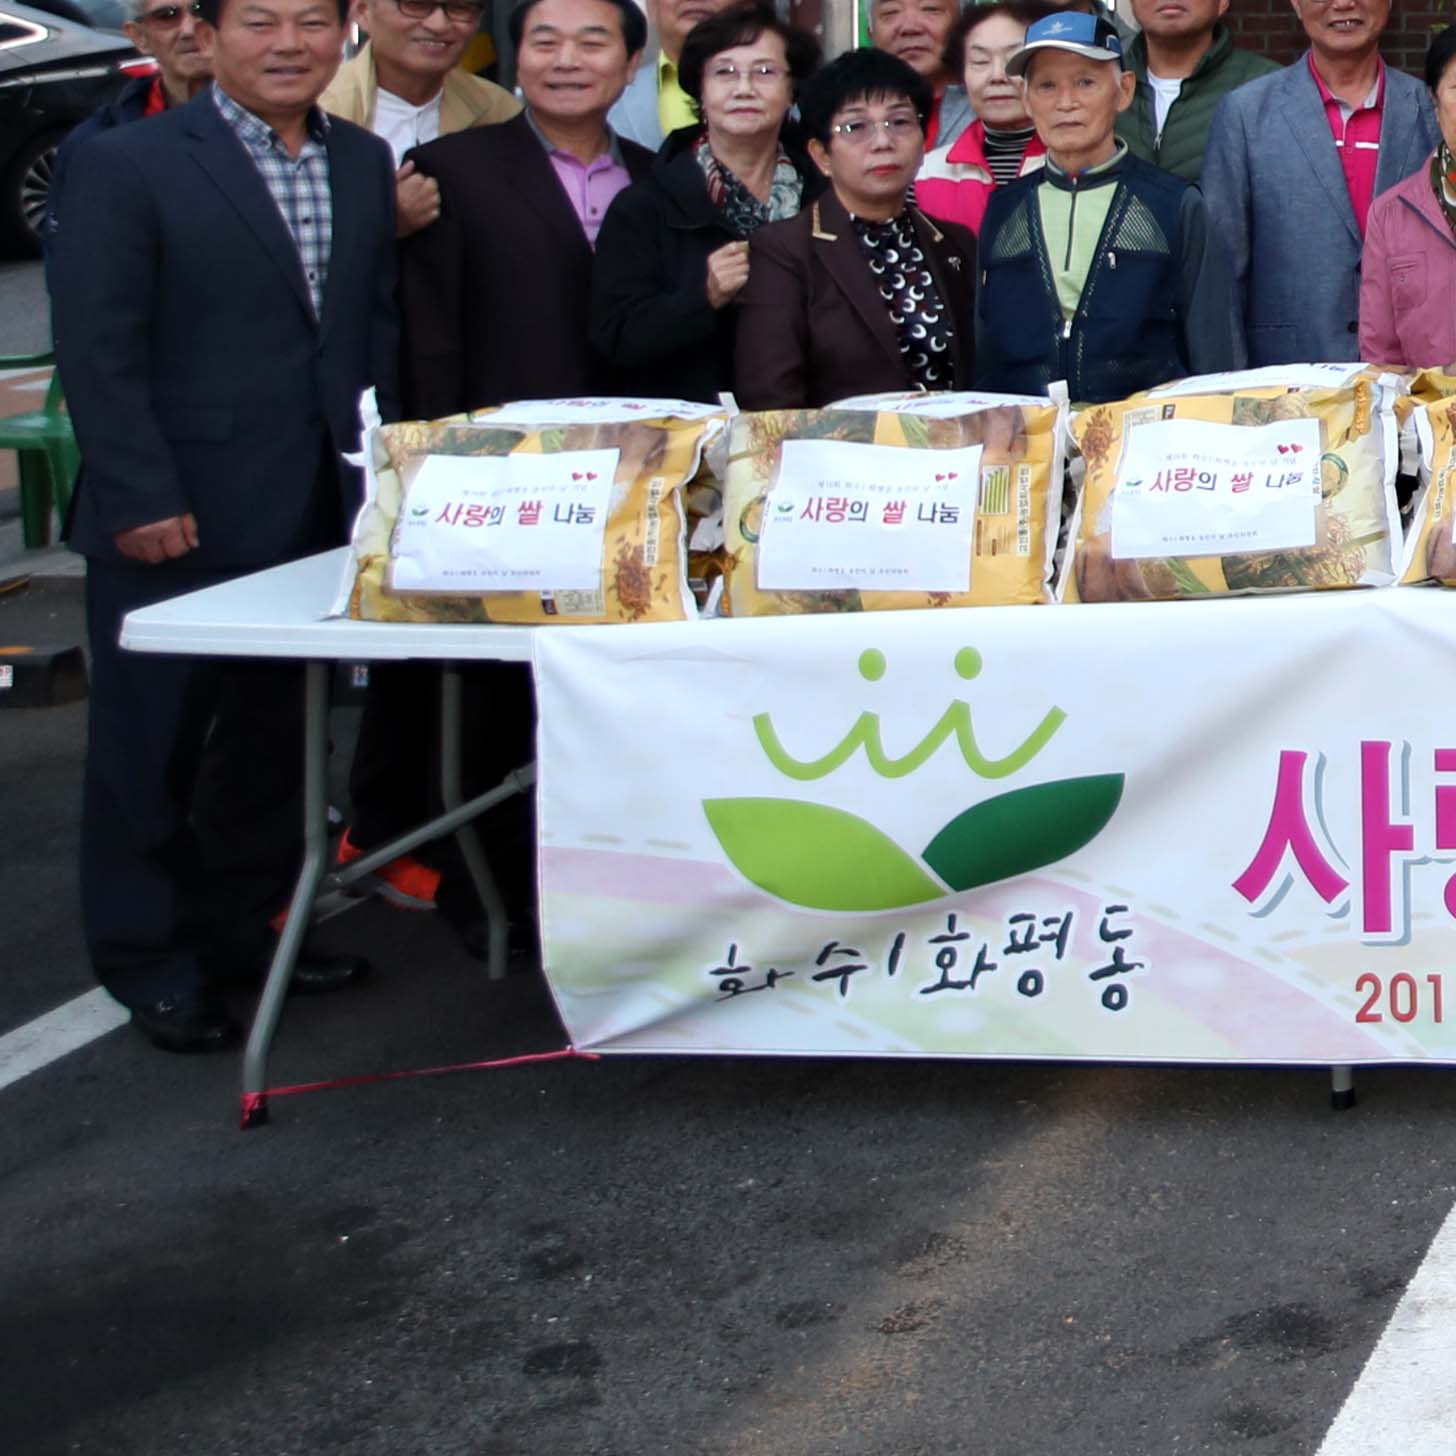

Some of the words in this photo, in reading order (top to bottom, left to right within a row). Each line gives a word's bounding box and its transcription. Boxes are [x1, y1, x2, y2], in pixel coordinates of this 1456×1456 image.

[1150, 467, 1217, 493] 사랑의
[1230, 470, 1255, 493] 쌀
[435, 501, 507, 528] 사랑의
[517, 500, 543, 526] 쌀
[553, 502, 596, 525] 나눔
[800, 496, 869, 523] 사랑의
[882, 500, 906, 524] 쌀
[917, 500, 960, 524] 나눔
